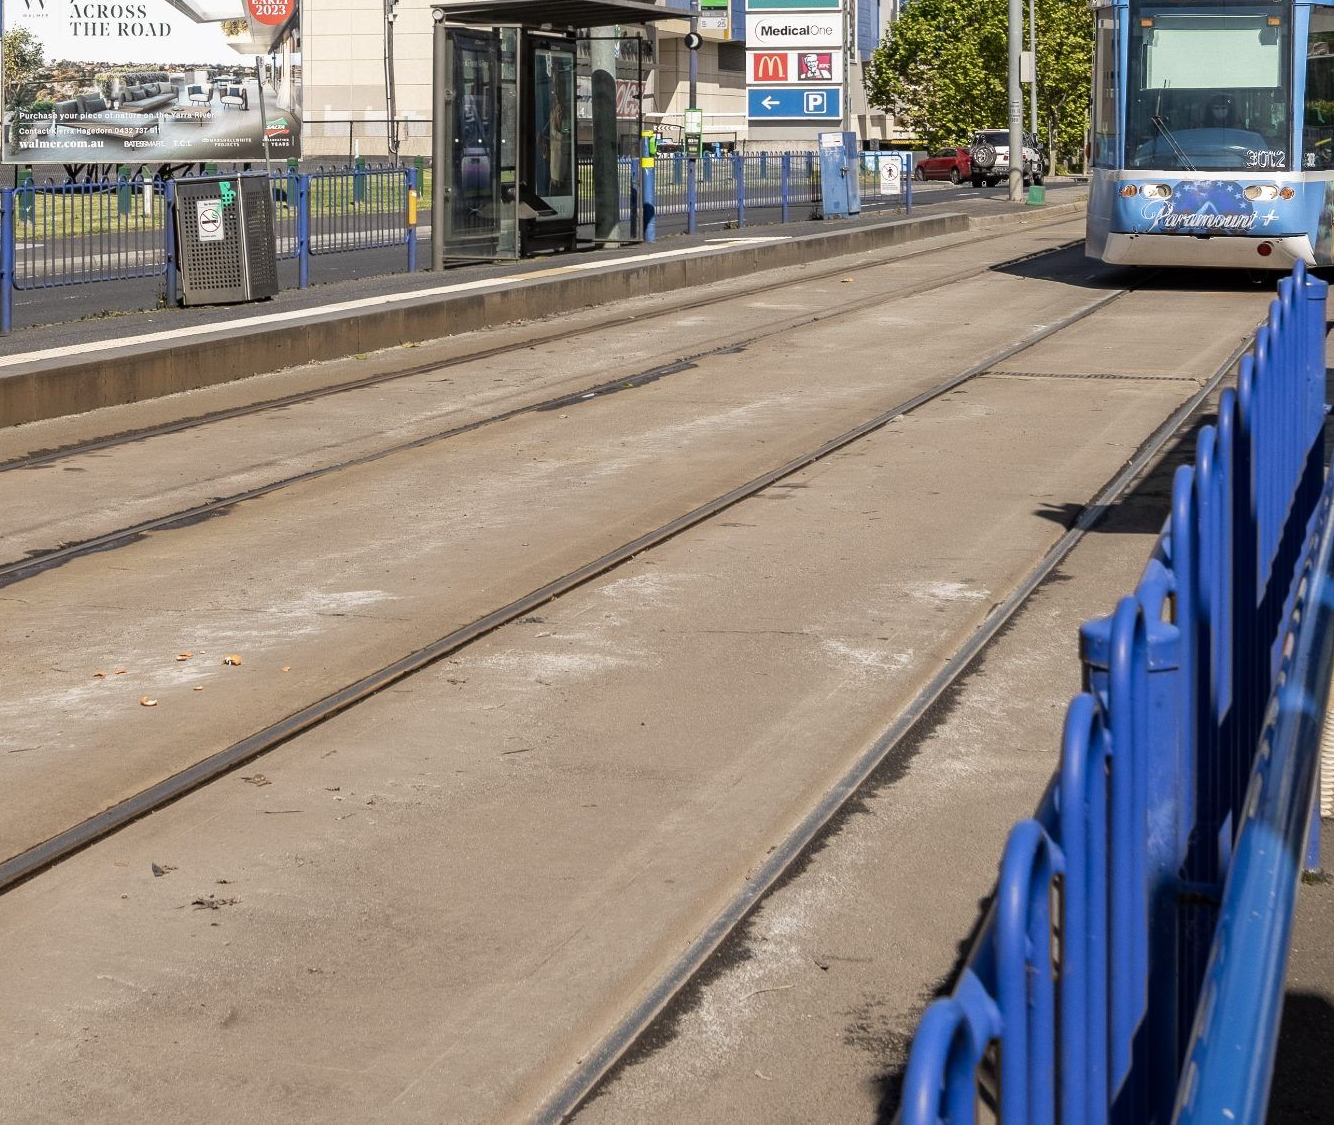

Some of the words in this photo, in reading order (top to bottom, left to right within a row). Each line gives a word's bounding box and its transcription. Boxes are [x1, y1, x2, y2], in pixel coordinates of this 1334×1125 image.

[70, 4, 147, 19] ACROSS
[255, 5, 286, 15] 2023
[69, 22, 110, 36] THE
[117, 23, 172, 36] ROAD
[717, 20, 727, 28] 25
[761, 25, 833, 36] MedicalOne
[19, 112, 58, 120] Purchase
[59, 113, 78, 121] your
[80, 112, 103, 120] piece
[19, 127, 49, 135] Contact
[76, 127, 113, 136] Hagedorn
[19, 139, 104, 148] walmer.com.au
[1246, 150, 1286, 168] 3012
